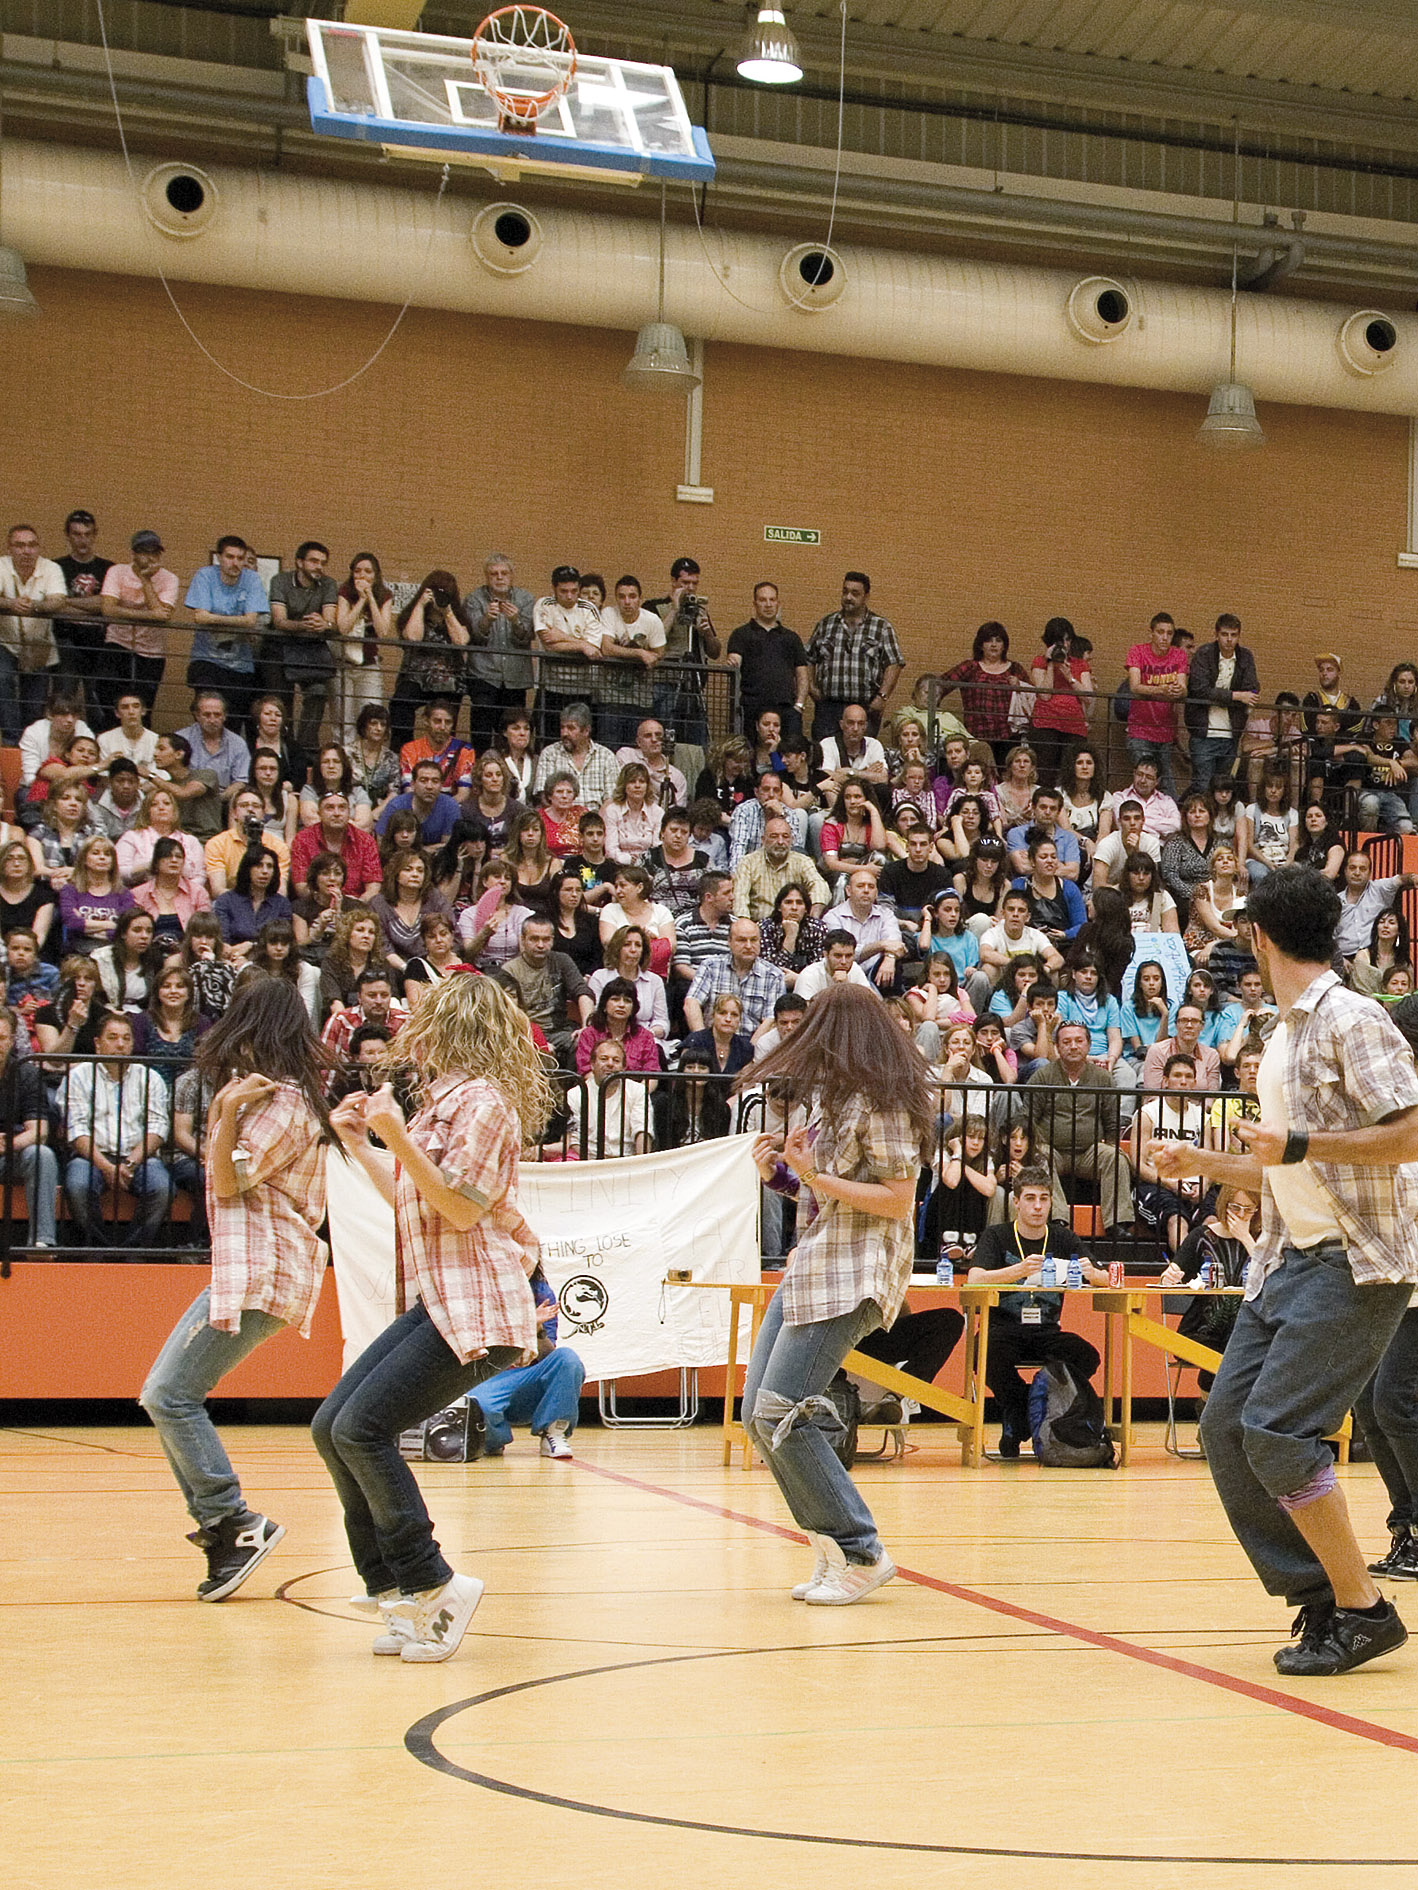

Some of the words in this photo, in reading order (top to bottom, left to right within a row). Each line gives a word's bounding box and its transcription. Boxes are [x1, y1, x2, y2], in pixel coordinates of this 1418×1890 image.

[767, 528, 803, 541] SALIDA
[596, 1232, 632, 1252] LOSE
[583, 1253, 604, 1269] TO
